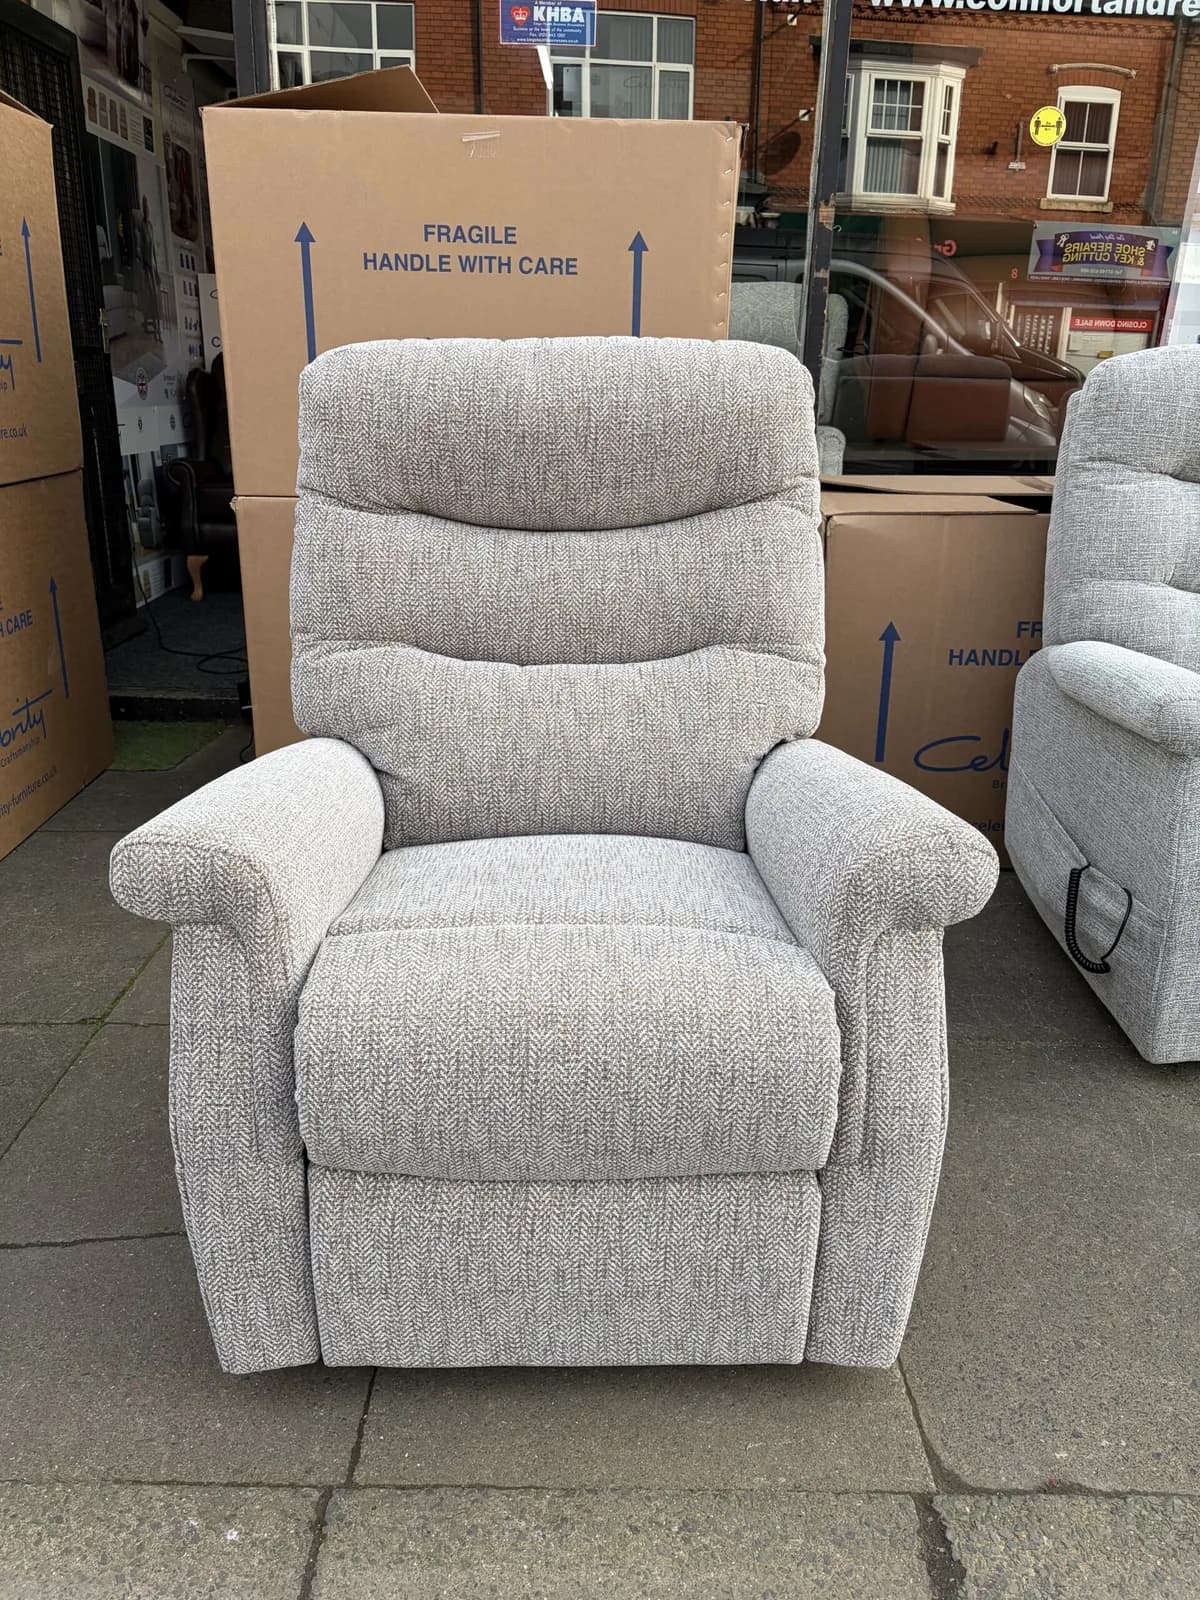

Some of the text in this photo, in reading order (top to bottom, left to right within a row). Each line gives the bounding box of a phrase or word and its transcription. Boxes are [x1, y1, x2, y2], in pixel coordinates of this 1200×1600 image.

[533, 5, 585, 23] KHBA
[423, 224, 517, 245] FRAGILE
[363, 252, 578, 276] HANDLE WITH CARE
[6, 609, 33, 635] CARE
[948, 648, 1041, 667] HANDL
